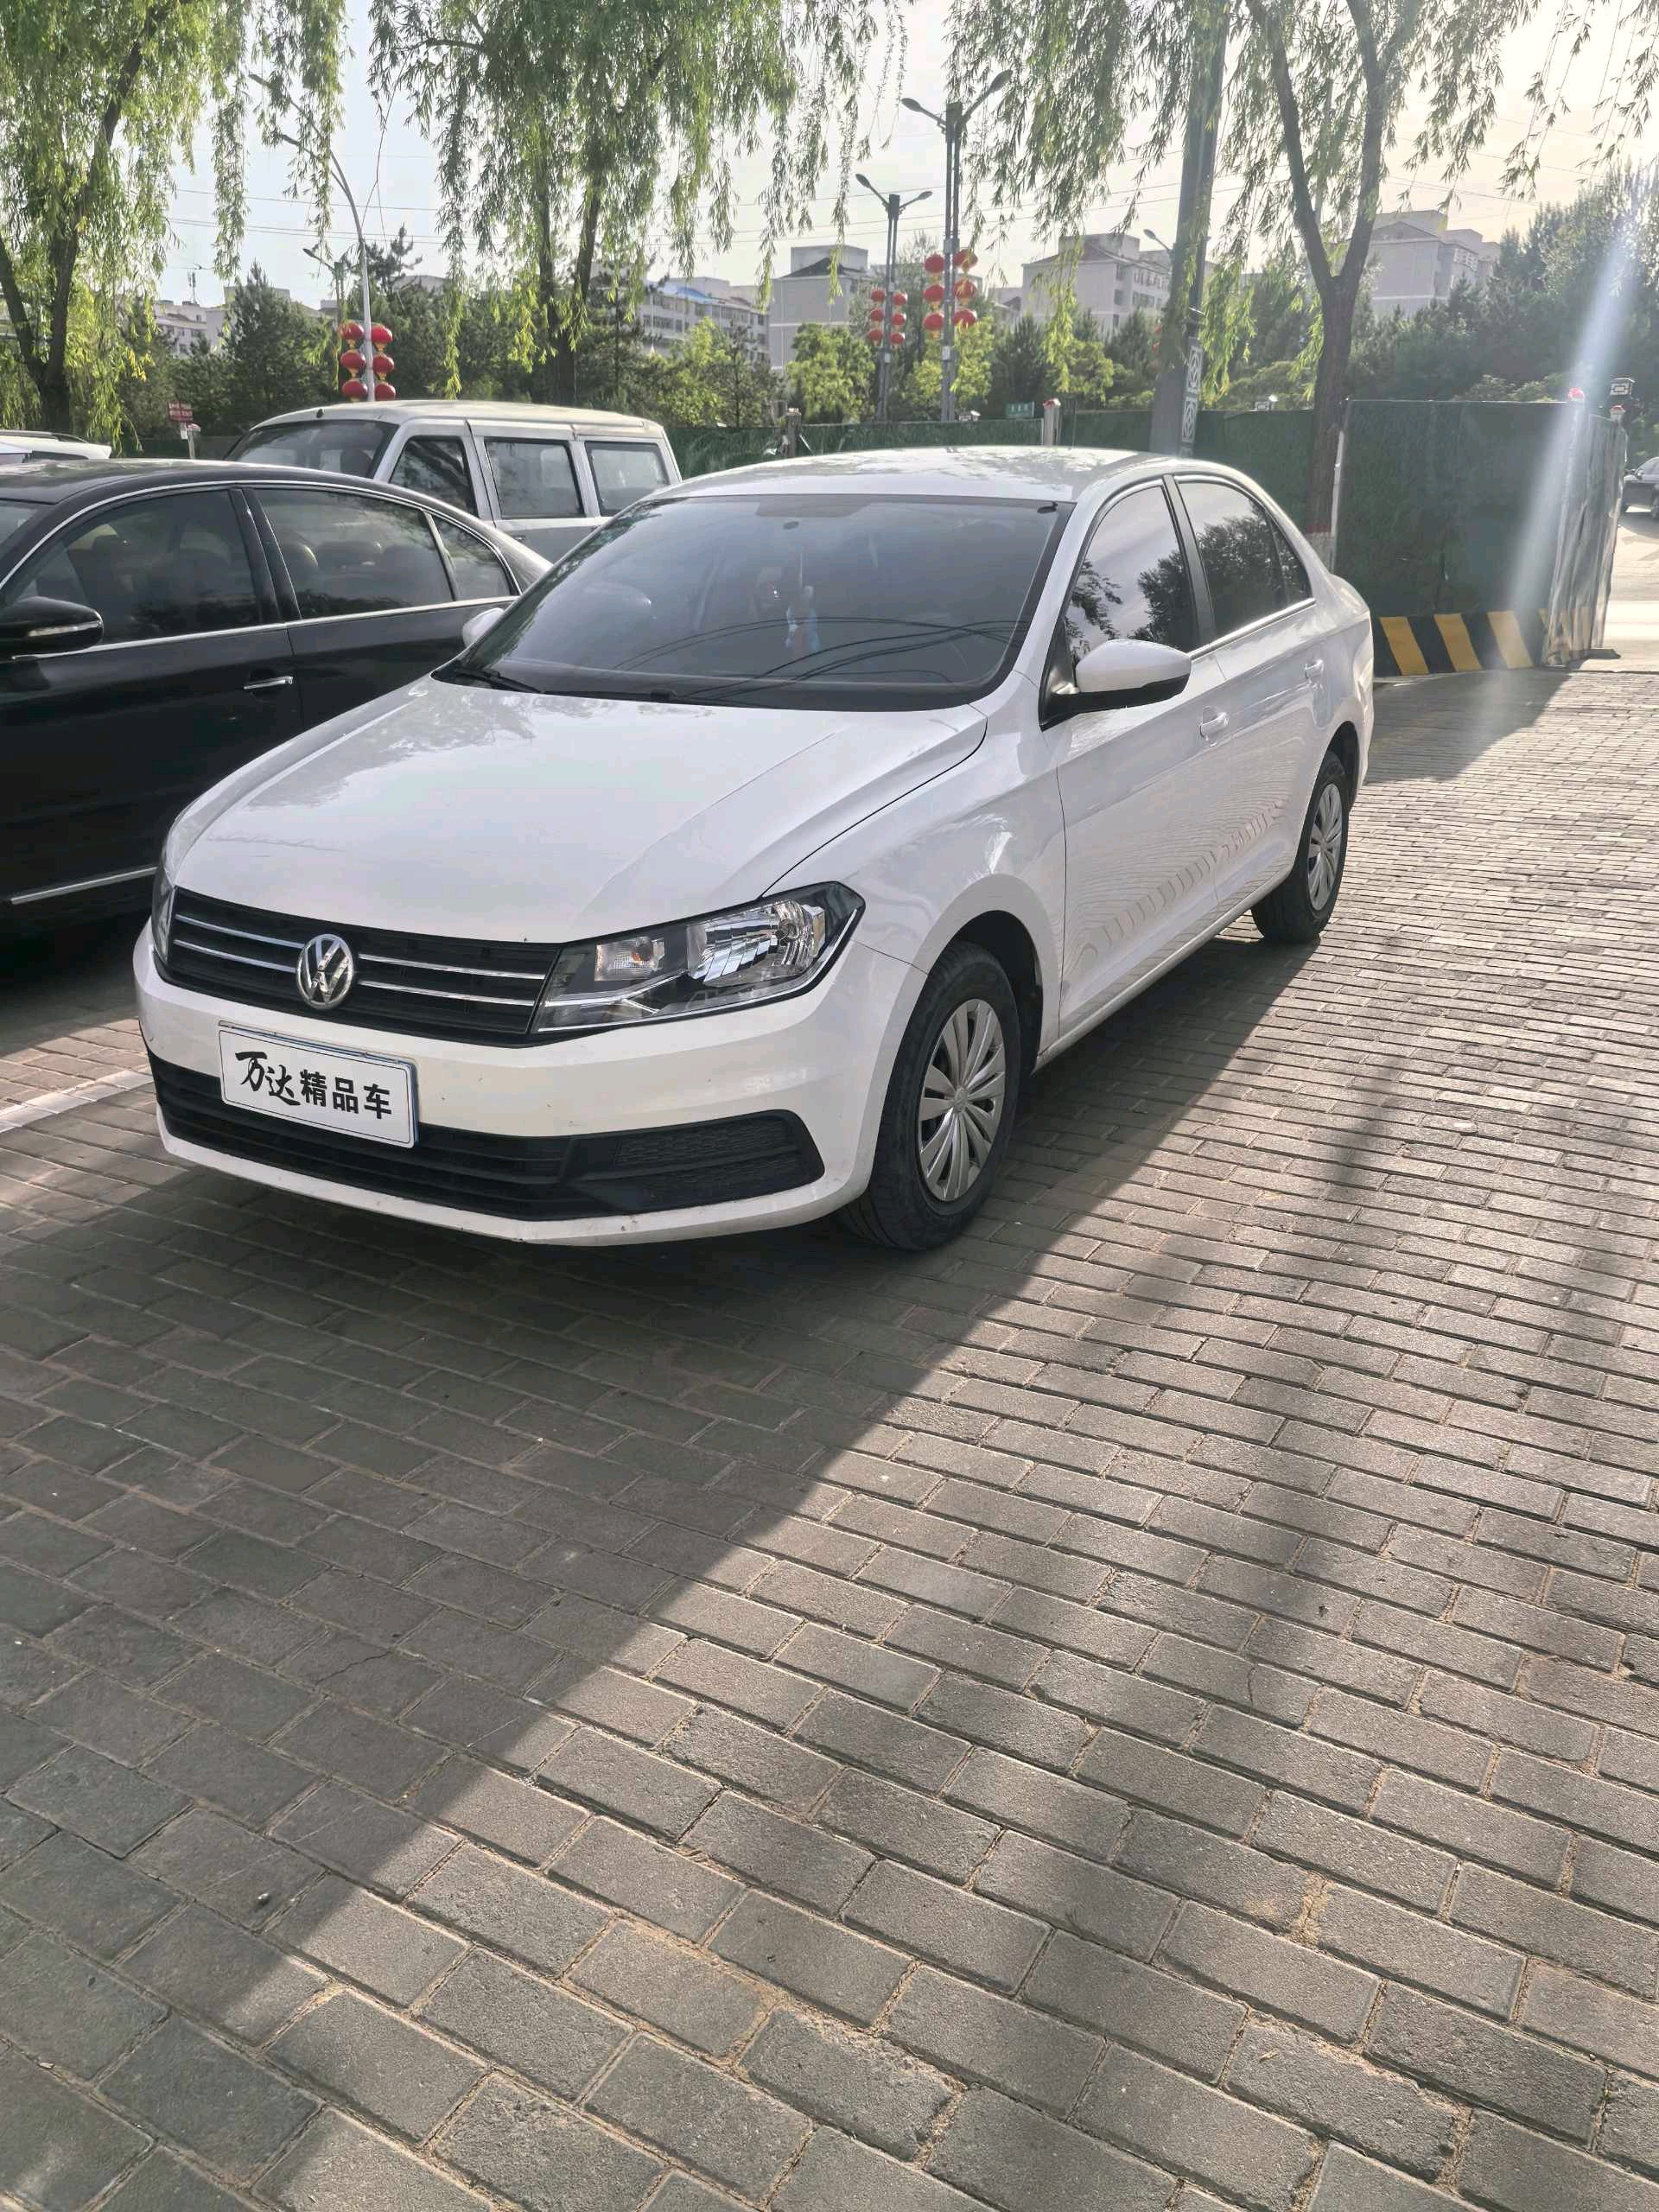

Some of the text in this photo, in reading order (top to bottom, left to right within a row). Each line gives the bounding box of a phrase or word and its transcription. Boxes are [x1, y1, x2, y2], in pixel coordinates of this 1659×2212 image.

[235, 1052, 391, 1119] 万达精品车
